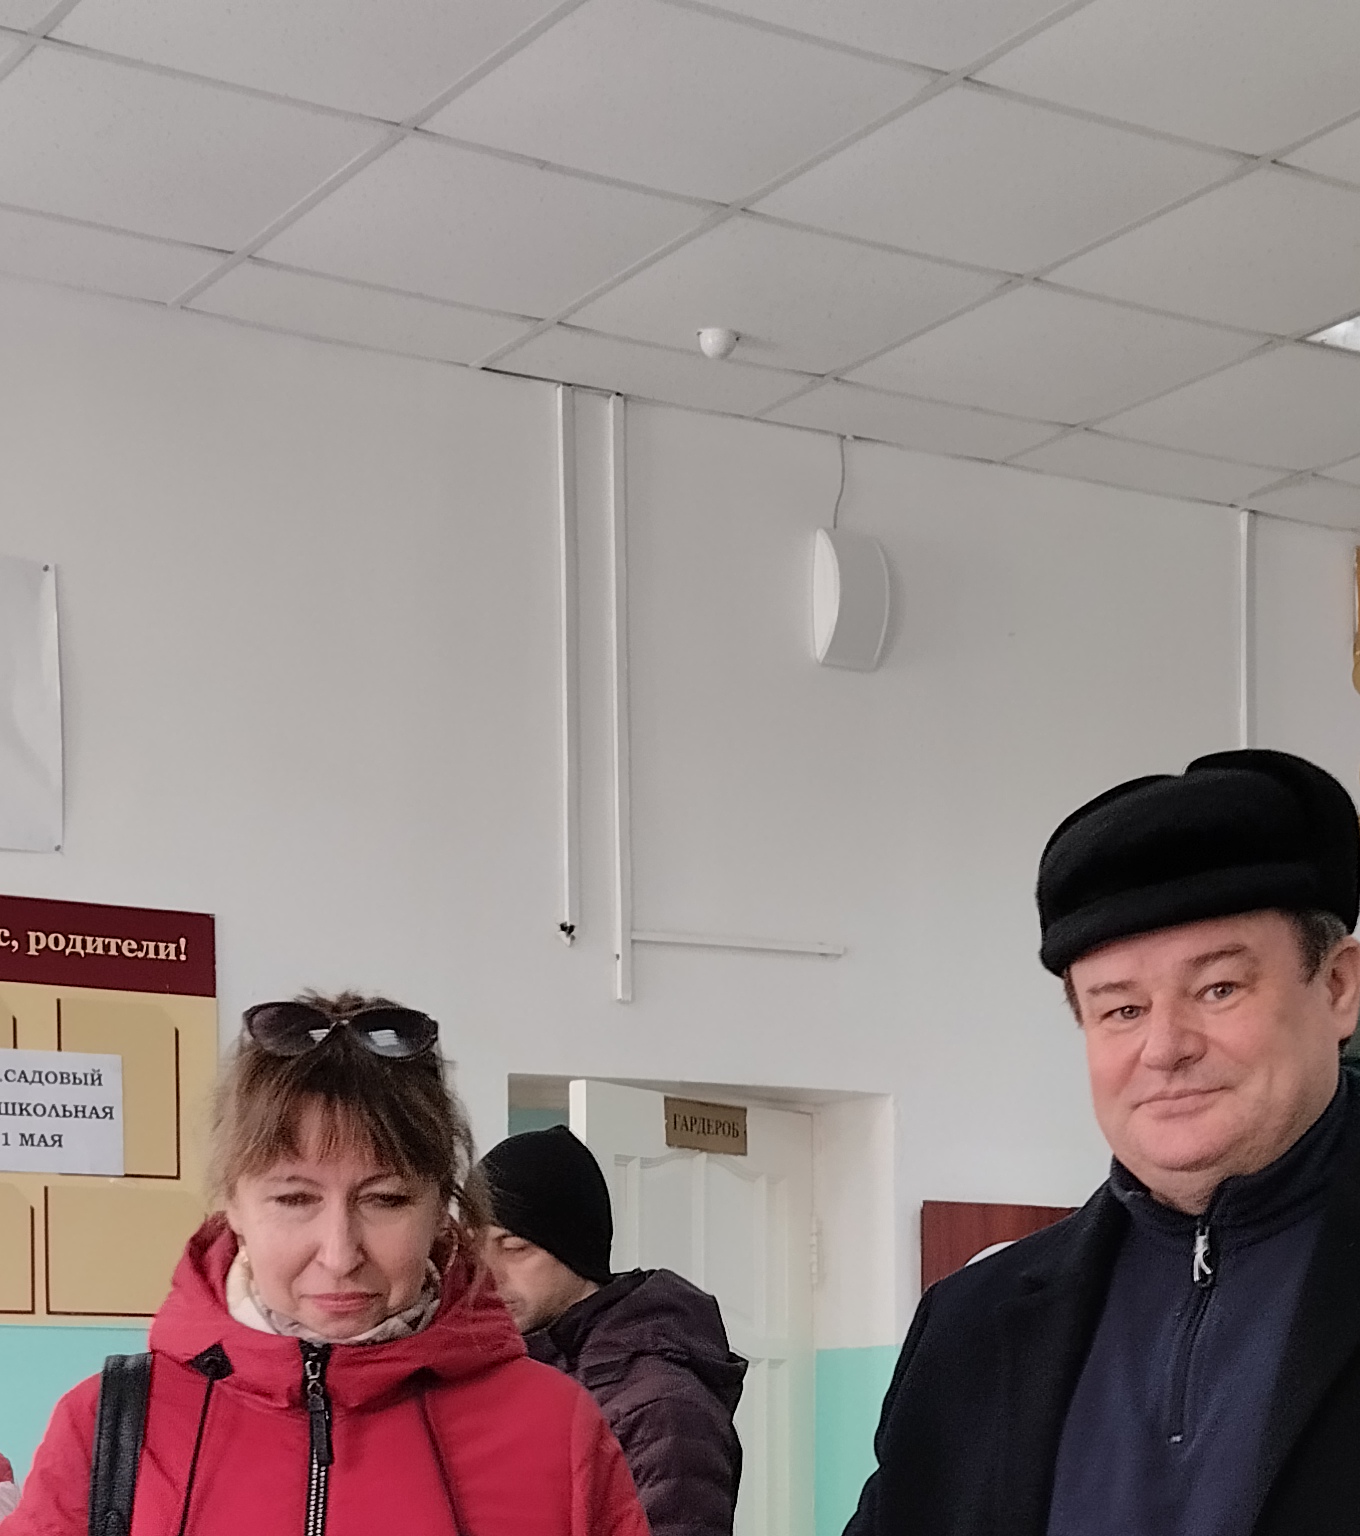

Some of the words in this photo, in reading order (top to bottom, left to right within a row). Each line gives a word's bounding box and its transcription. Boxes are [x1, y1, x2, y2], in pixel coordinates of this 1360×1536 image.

[26, 928, 187, 961] родители!
[673, 1113, 739, 1138] ГАРДЕРОБ
[18, 1133, 63, 1148] МАЯ
